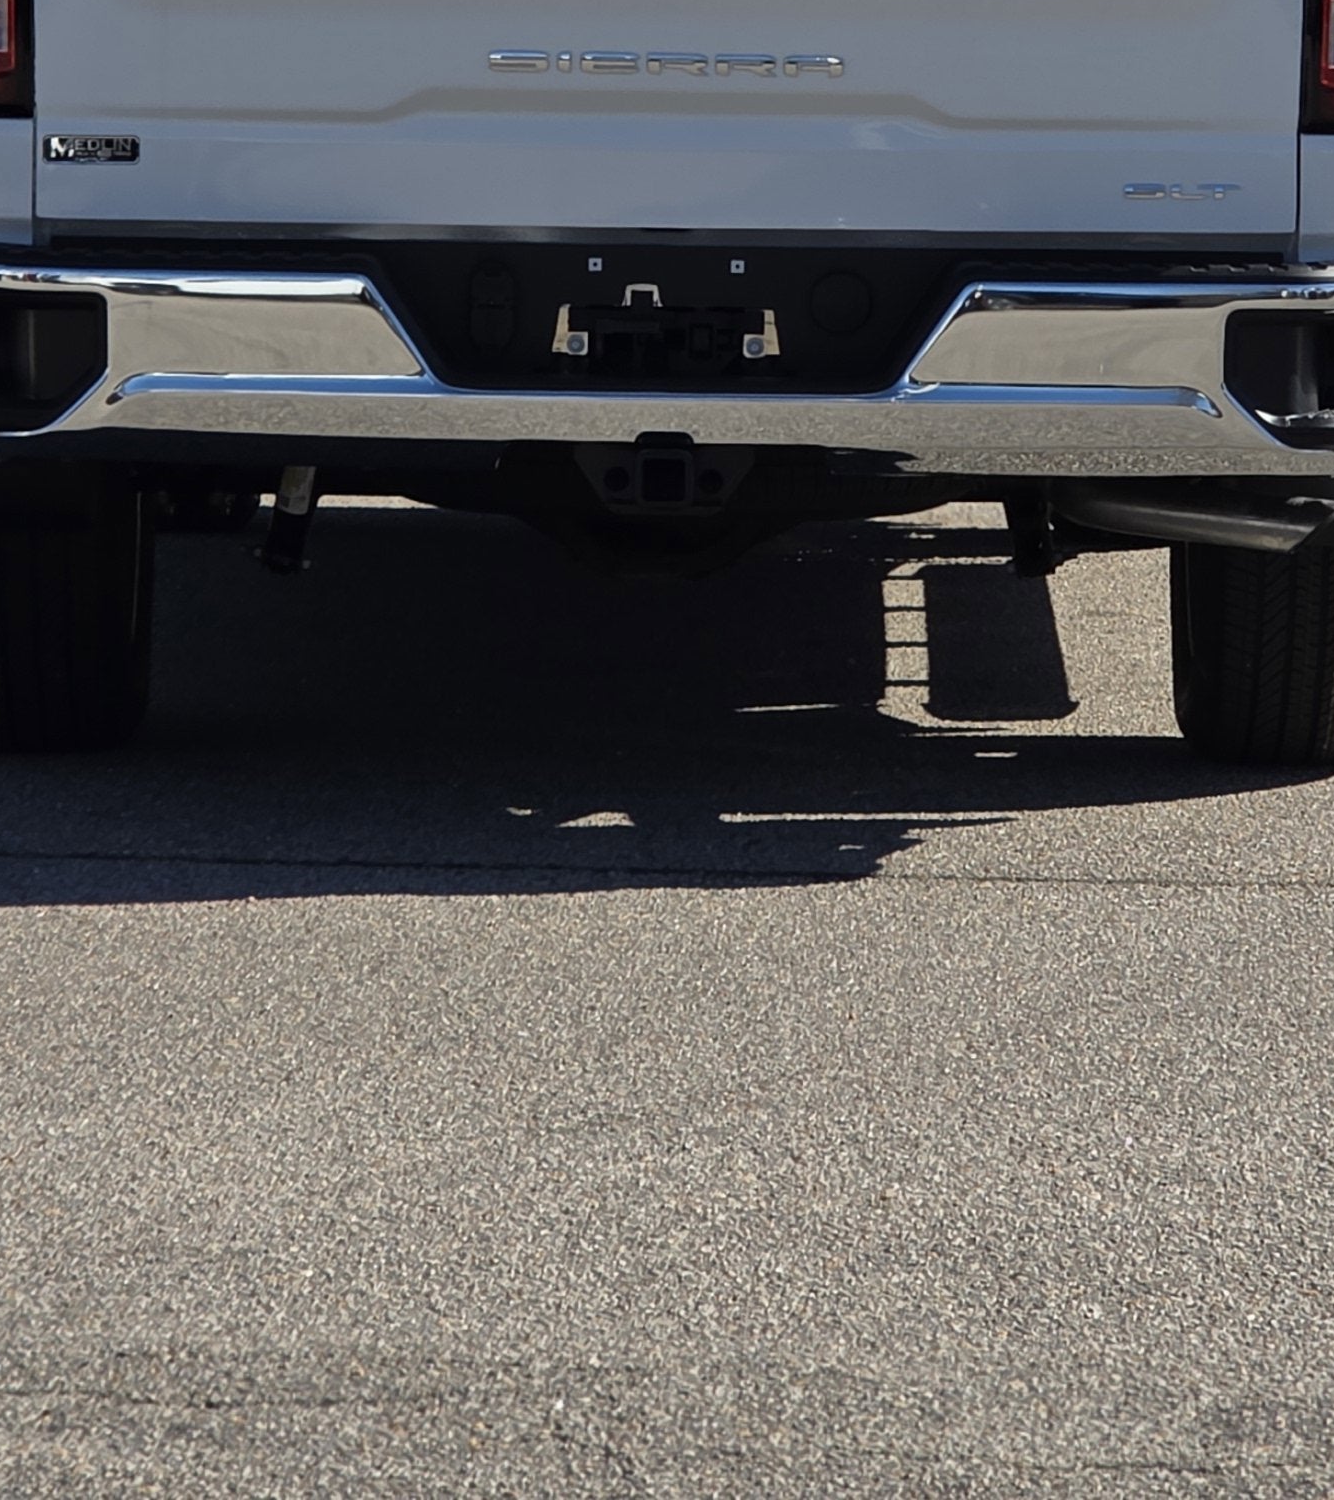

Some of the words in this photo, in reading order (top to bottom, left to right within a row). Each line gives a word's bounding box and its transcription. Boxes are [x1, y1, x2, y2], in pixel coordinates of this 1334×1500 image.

[487, 49, 845, 79] SIERRA
[49, 136, 133, 158] MEDLIN
[1123, 182, 1242, 201] SLT
